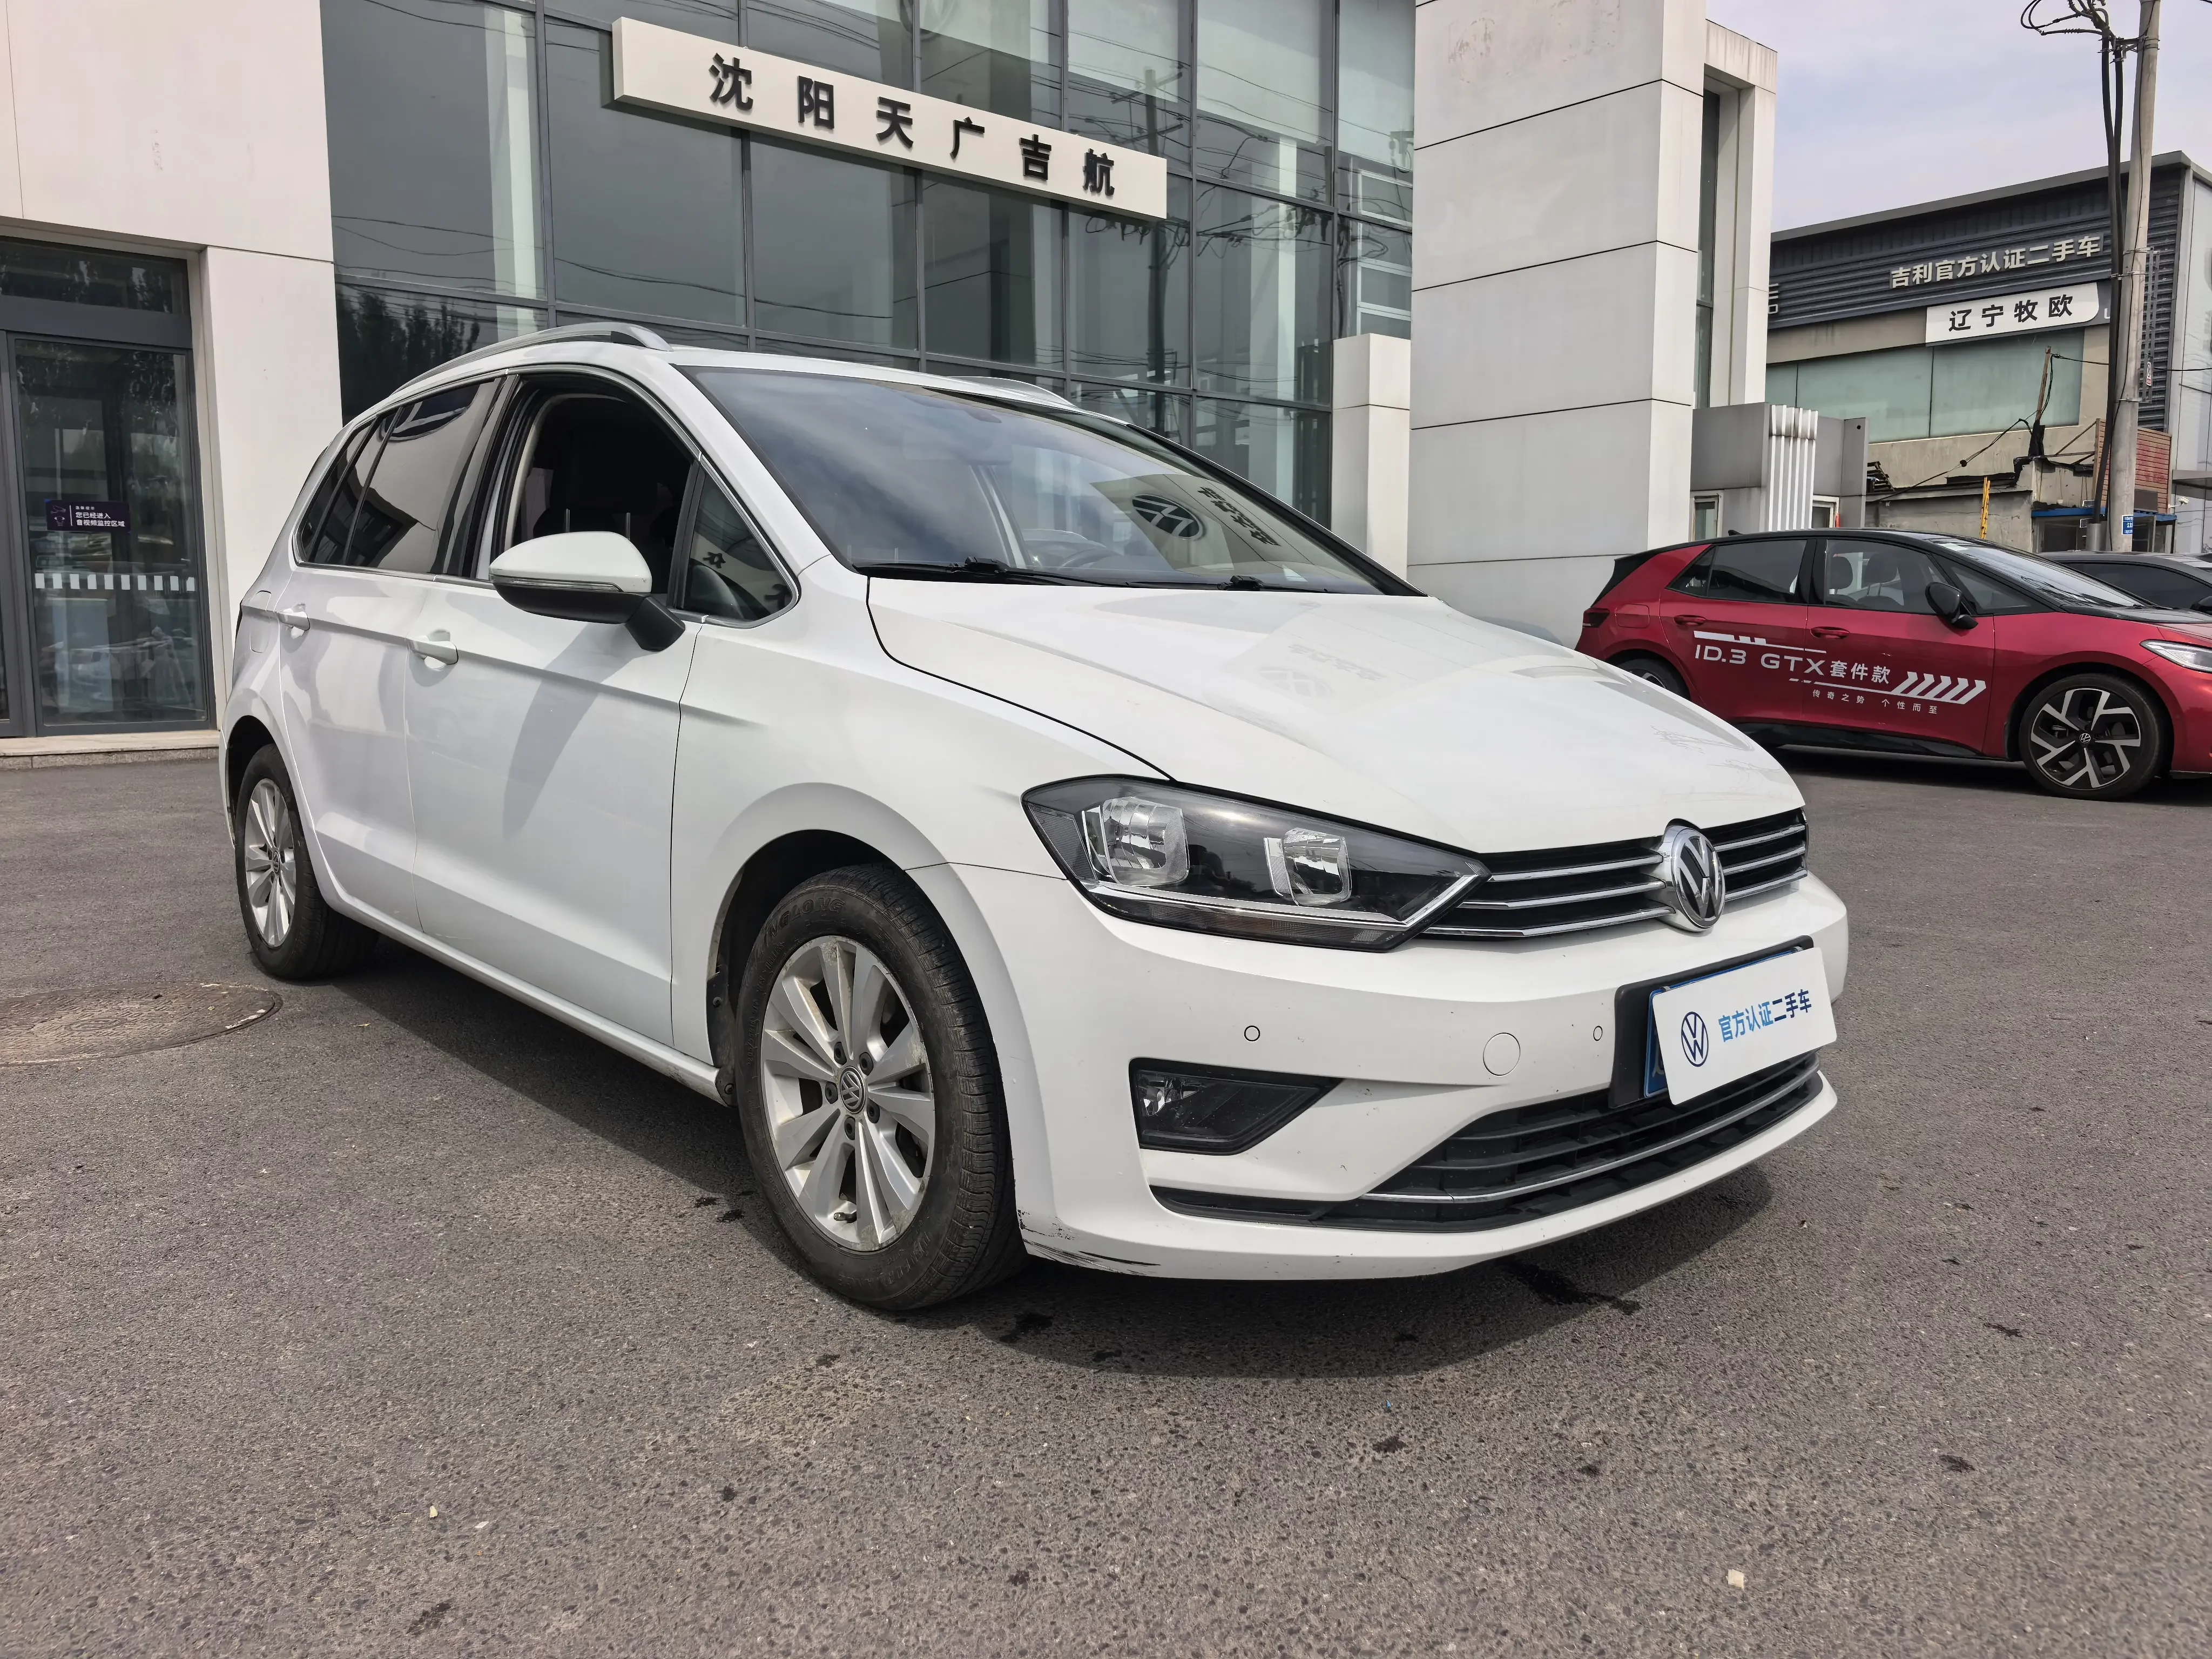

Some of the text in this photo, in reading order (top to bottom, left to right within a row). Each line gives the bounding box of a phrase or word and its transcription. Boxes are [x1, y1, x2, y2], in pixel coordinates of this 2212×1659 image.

[709, 52, 1115, 197] 沈阳天广吉航
[1891, 235, 2101, 288] 吉利官方认证二手车
[1948, 294, 2073, 332] 辽宁牧欧
[1695, 644, 1747, 665] ID.3
[1718, 989, 1812, 1042] 官方认证二手车
